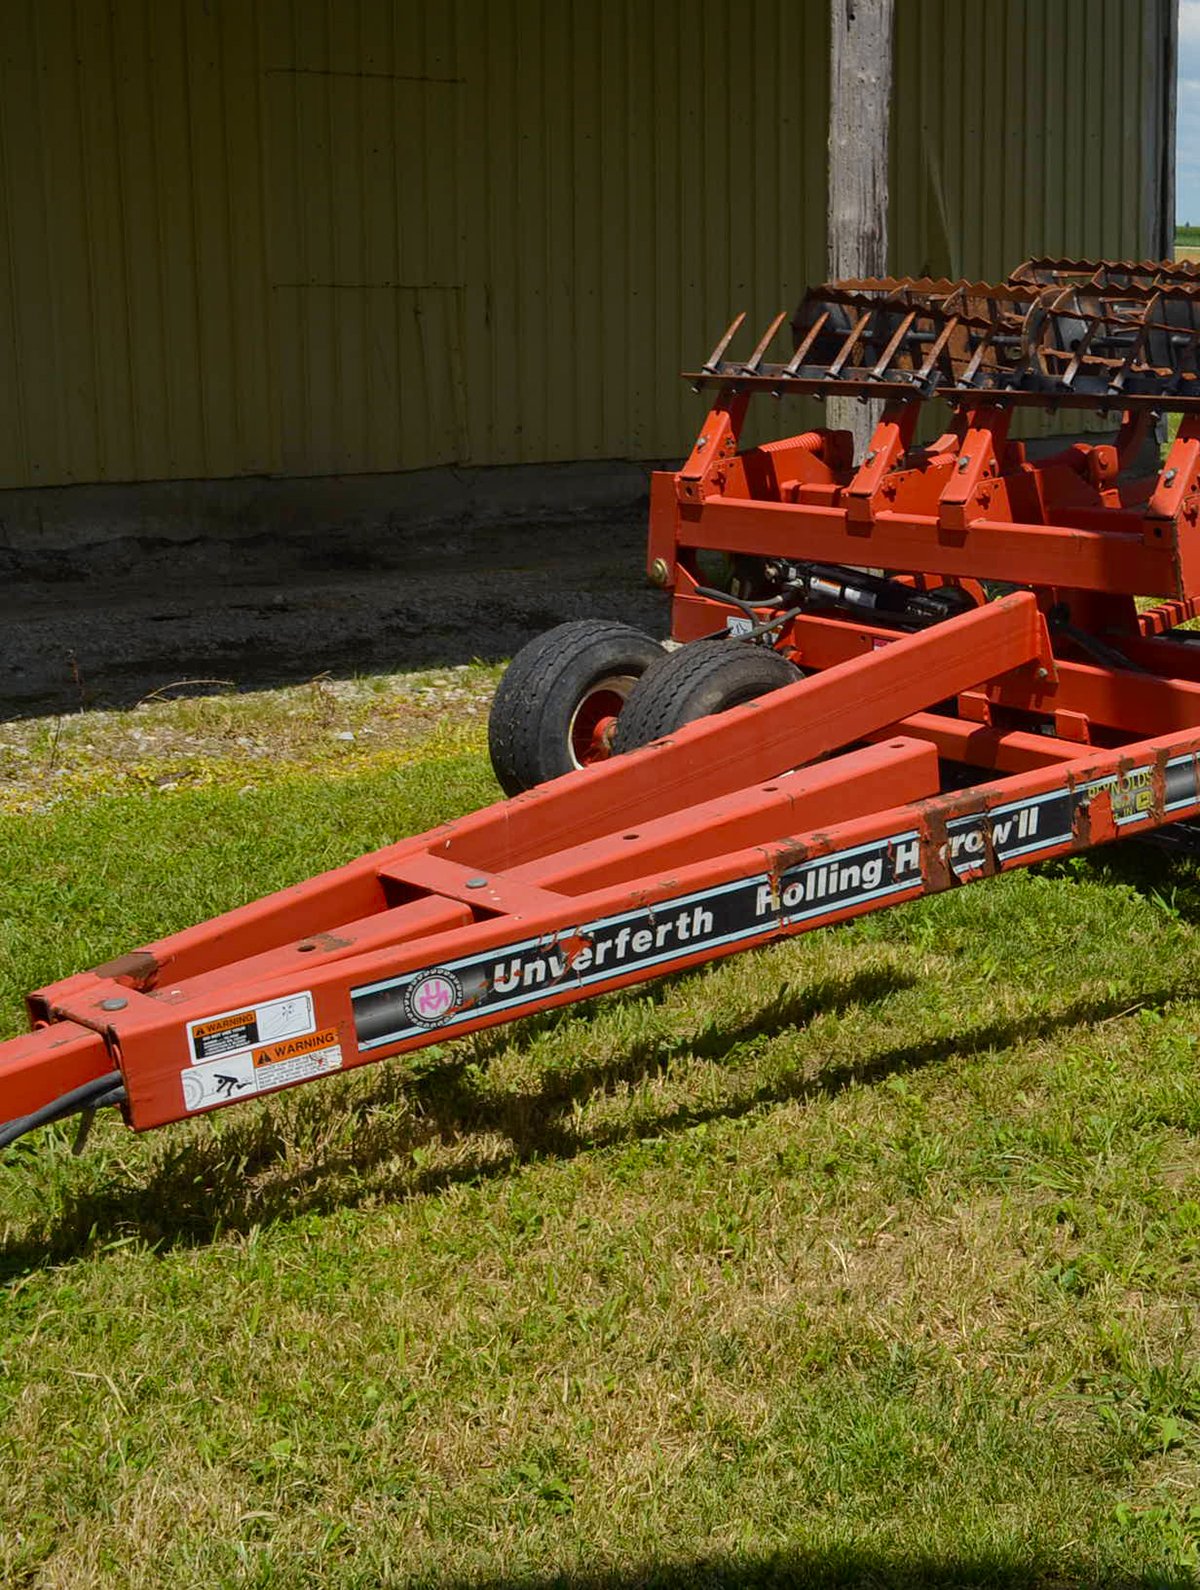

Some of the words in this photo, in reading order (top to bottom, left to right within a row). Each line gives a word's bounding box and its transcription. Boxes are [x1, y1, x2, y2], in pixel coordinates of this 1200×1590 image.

[493, 906, 714, 994] Unverferth
[755, 856, 883, 916] Rolling
[895, 820, 1013, 876] Hrow
[207, 1013, 253, 1032] WARNING
[274, 1033, 335, 1057] WARNING
